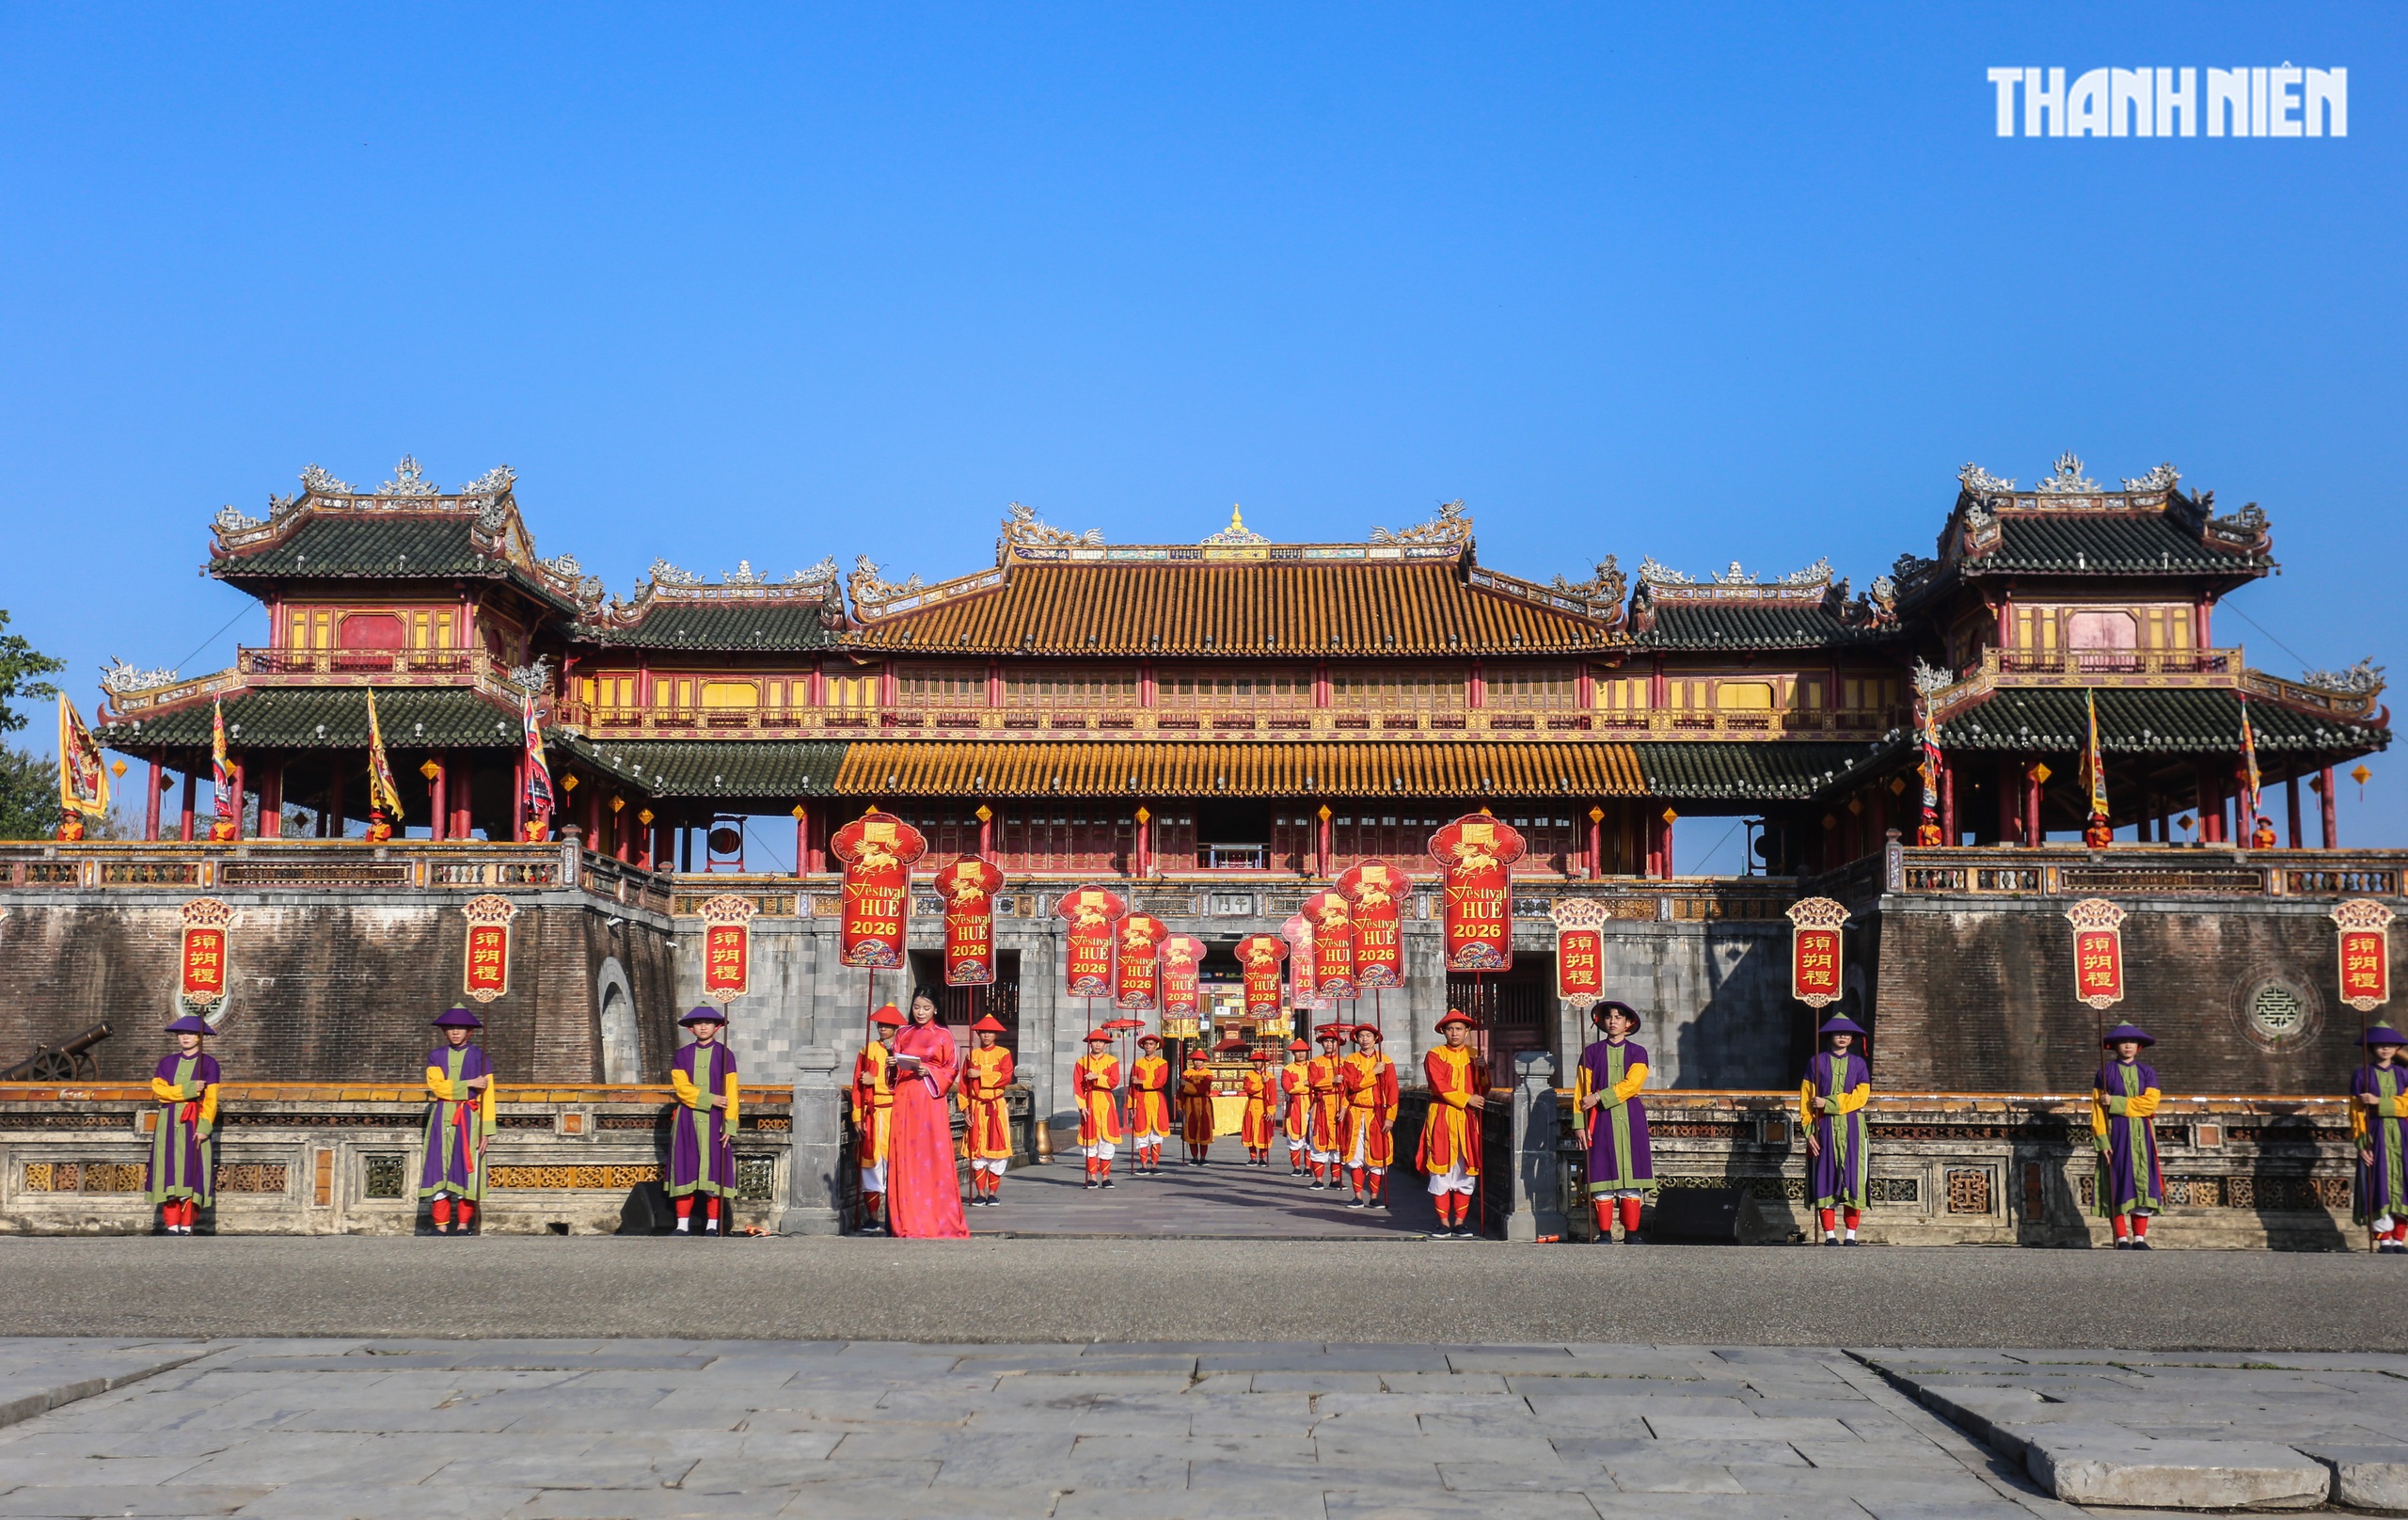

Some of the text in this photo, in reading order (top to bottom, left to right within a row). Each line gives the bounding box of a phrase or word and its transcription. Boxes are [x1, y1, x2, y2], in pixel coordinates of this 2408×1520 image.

[845, 874, 905, 903] Festival
[1446, 875, 1507, 908] Festival
[946, 905, 990, 932] Festival
[1351, 909, 1399, 937] Festival
[850, 921, 897, 936] 2026
[1453, 924, 1501, 938] 2026
[1313, 930, 1350, 954] Festiv
[952, 944, 987, 957] 2026
[1357, 949, 1396, 961] 2026
[1072, 963, 1107, 974] 2026
[1121, 979, 1152, 990] 2026
[1167, 992, 1194, 1002] 2026
[1249, 992, 1276, 1002] 2026
